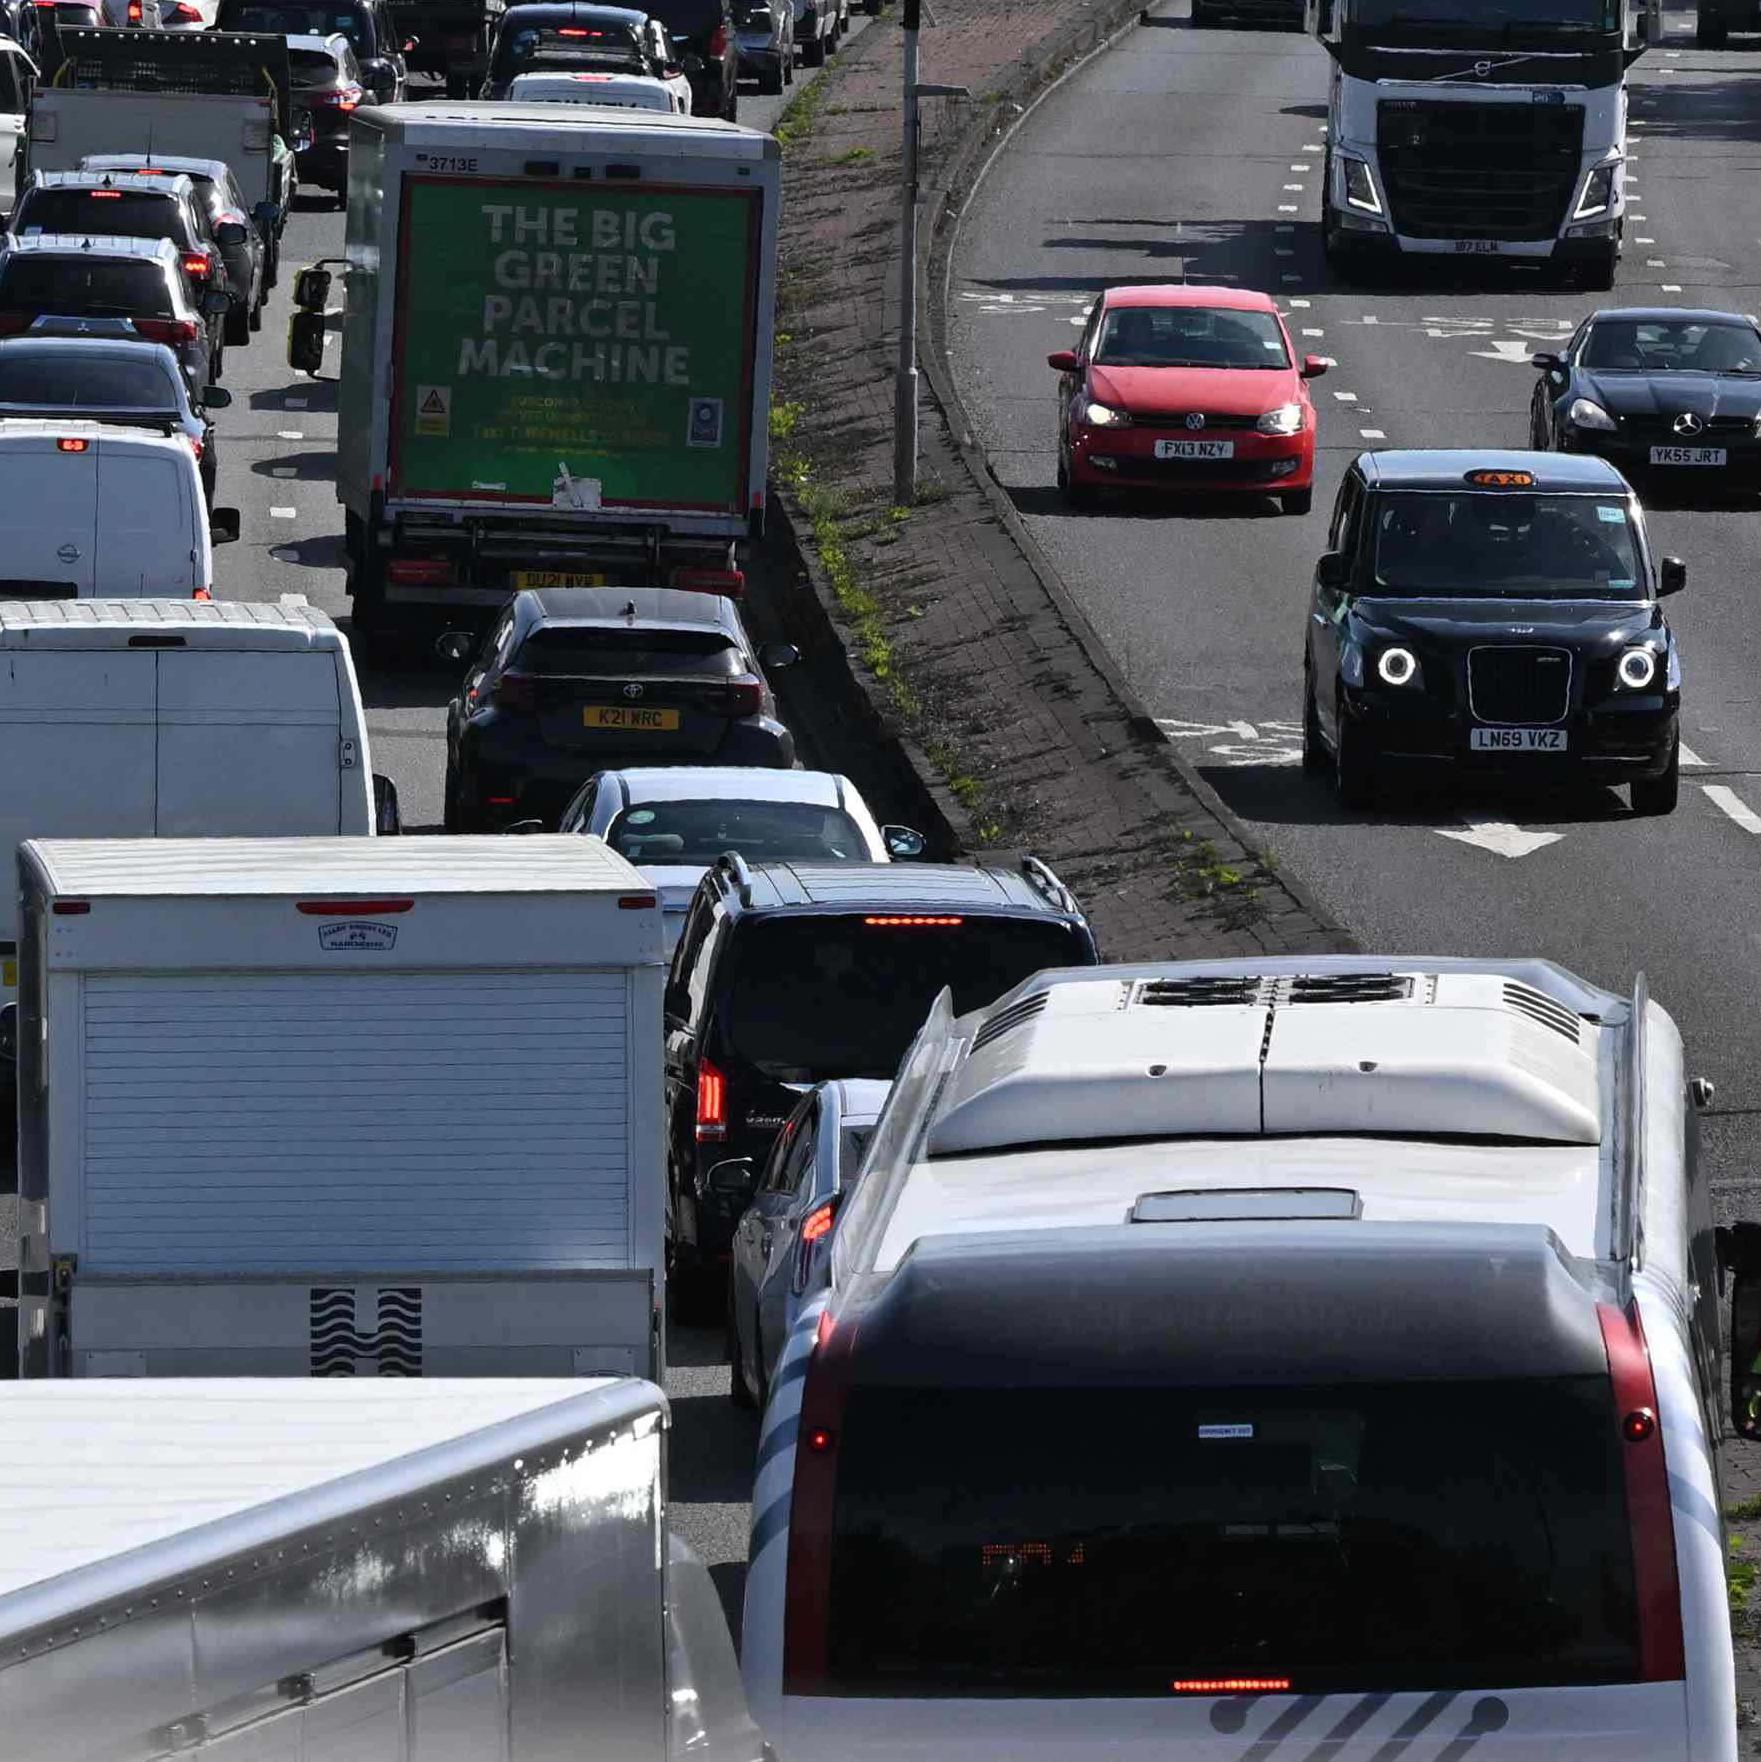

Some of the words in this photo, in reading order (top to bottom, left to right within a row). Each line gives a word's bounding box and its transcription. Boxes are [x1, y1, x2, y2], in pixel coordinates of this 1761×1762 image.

[429, 156, 479, 172] 3713E
[482, 205, 576, 247] THE
[591, 209, 675, 251] BIG
[494, 250, 658, 295] GREEN
[484, 294, 669, 340] PARCEL
[458, 339, 690, 385] MACHINE
[1164, 441, 1196, 456] FX13
[1198, 442, 1226, 457] NZY
[1655, 448, 1693, 462] YK55
[1694, 449, 1721, 463] JRT
[1478, 472, 1529, 486] TAXI
[1479, 730, 1523, 749] LN69
[1529, 731, 1560, 749] VKZ
